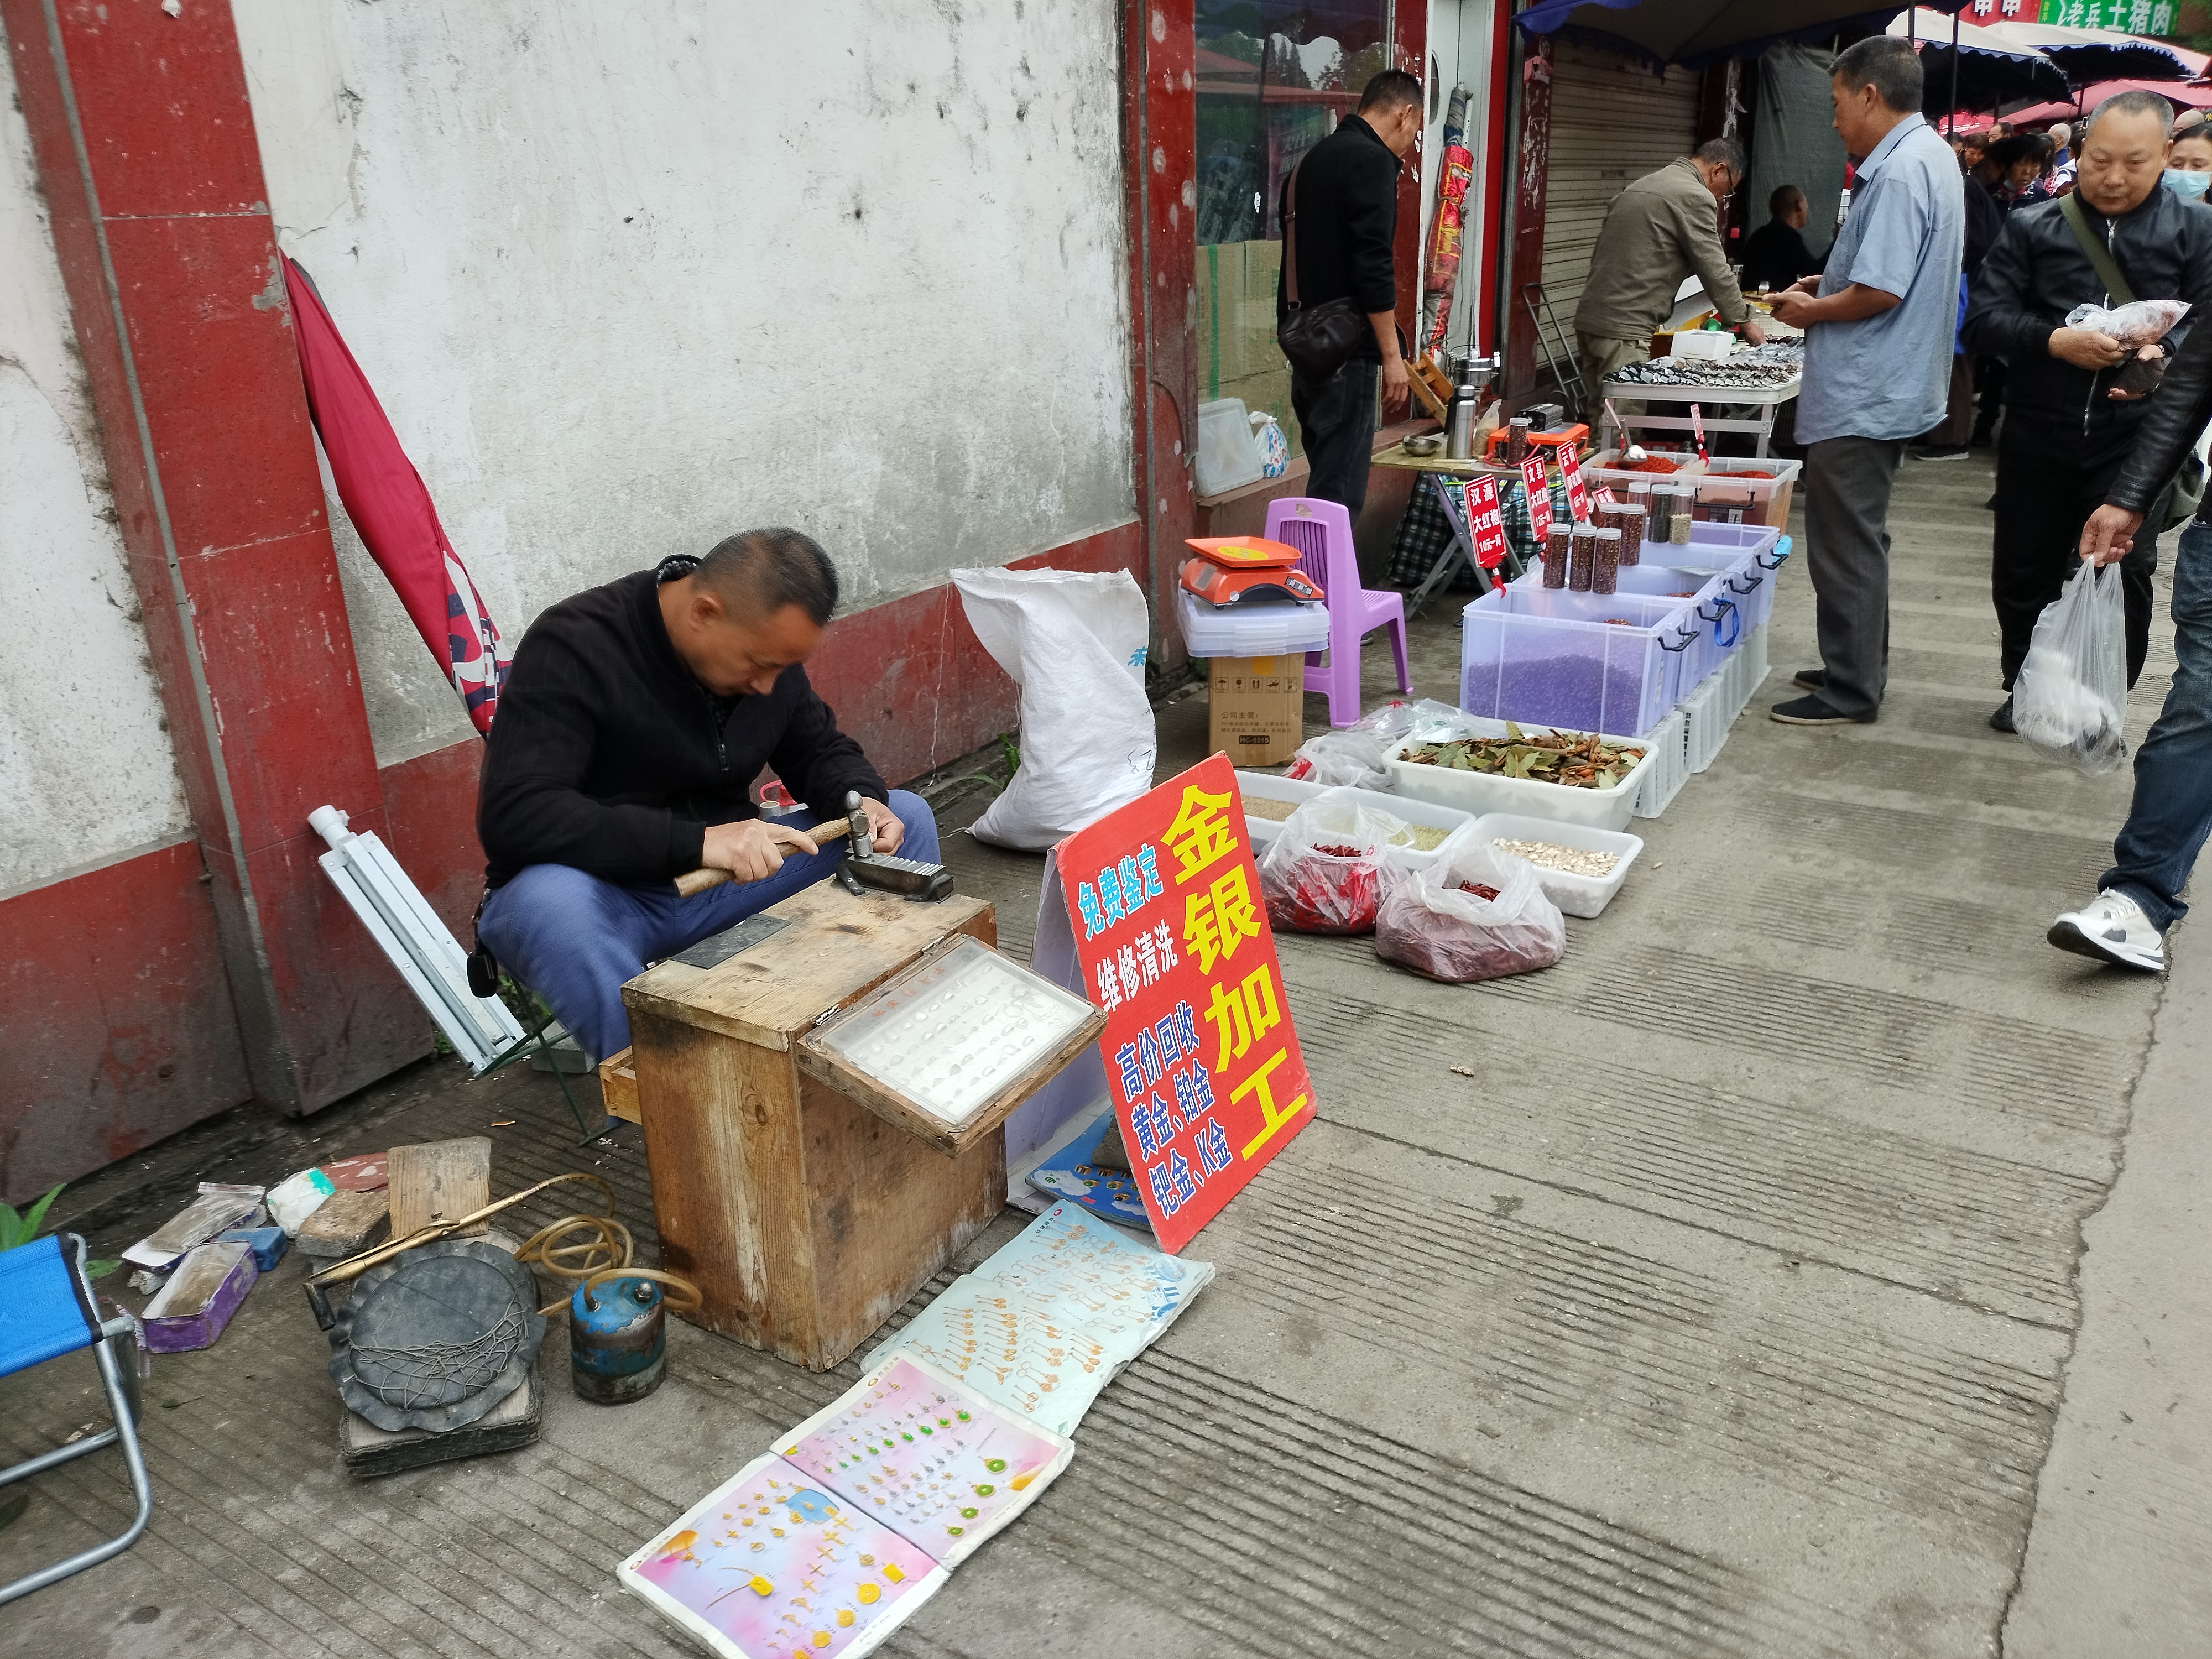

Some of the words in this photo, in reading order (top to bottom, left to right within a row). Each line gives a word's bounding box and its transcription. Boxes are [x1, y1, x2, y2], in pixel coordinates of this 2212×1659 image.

[1470, 482, 1494, 507] 汉源
[1527, 462, 1543, 484] 文县
[1473, 508, 1500, 534] 大红袍
[1079, 843, 1163, 942] 免费鉴定
[1096, 919, 1178, 1013] 维修清洗
[1161, 784, 1307, 1160] 金银加工
[1115, 1001, 1199, 1103] 高价回收
